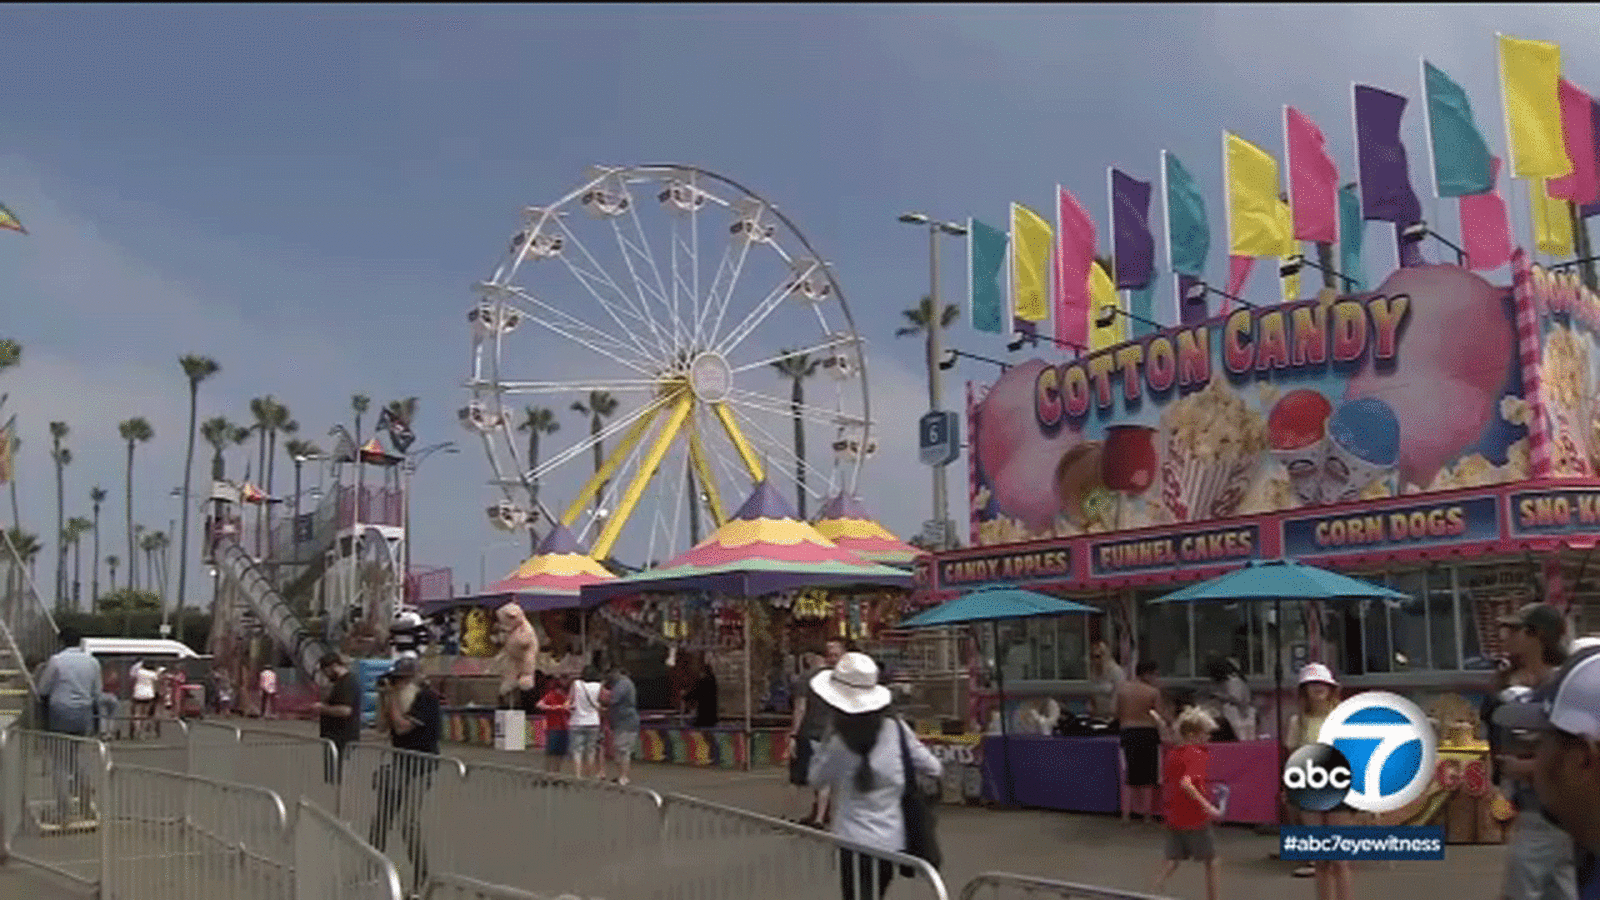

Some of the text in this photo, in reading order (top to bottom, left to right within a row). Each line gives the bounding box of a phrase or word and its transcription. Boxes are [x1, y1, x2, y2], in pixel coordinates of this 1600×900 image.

[1034, 293, 1412, 431] COTTON CANDY
[928, 424, 939, 444] 6
[1315, 506, 1466, 546] CORN DOGS
[944, 558, 1003, 581] CANDY
[1003, 550, 1067, 578] APPLES
[1101, 529, 1252, 567] FUNNEL CAKES
